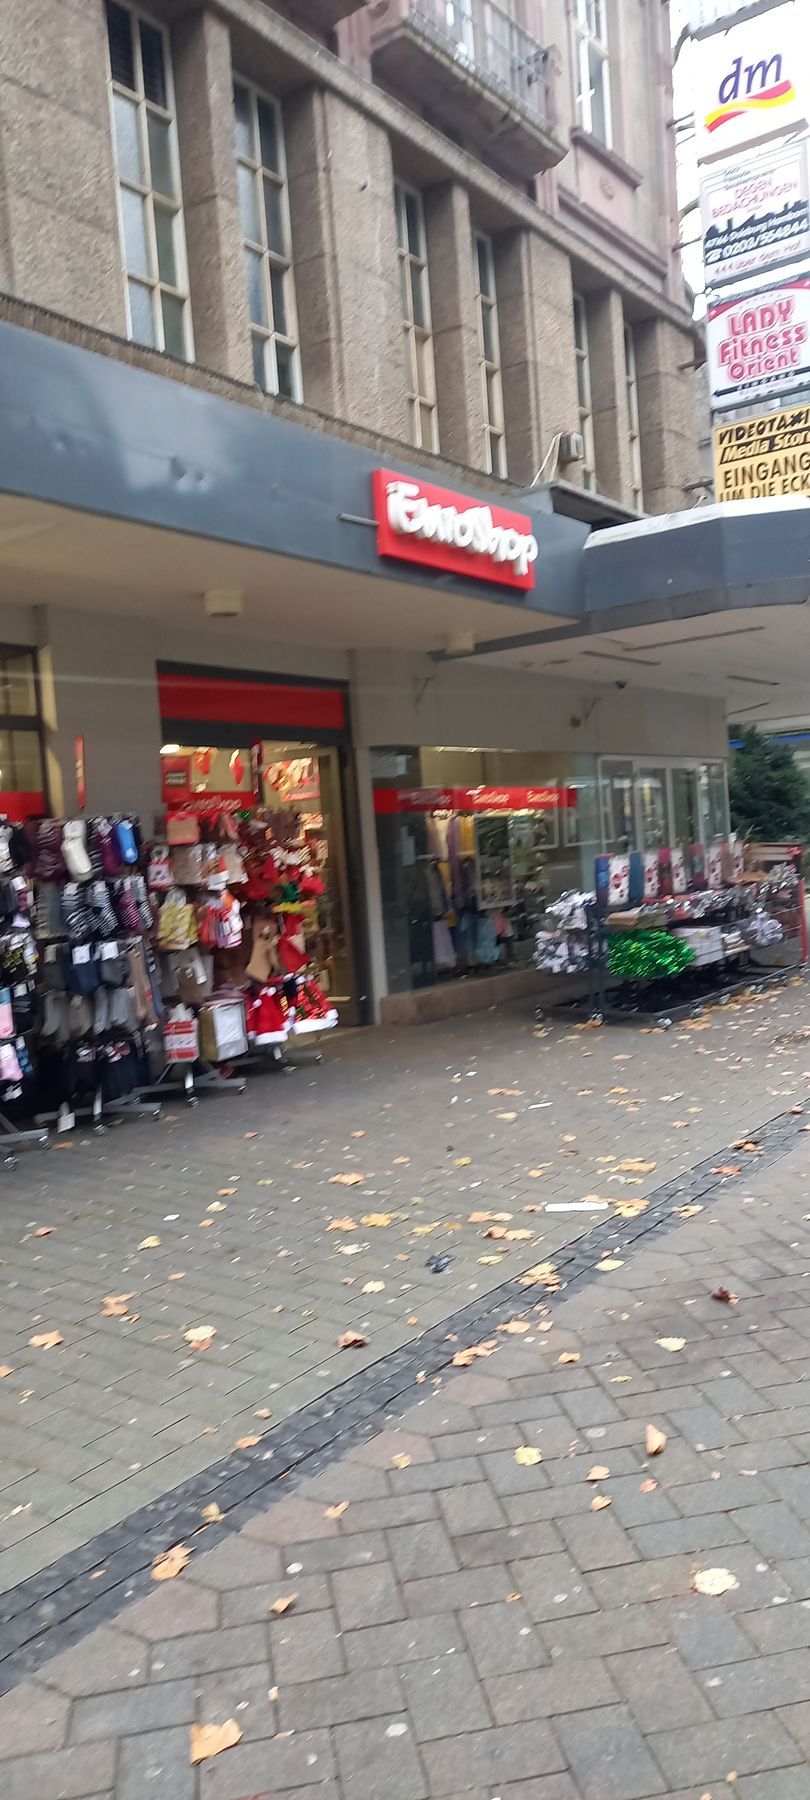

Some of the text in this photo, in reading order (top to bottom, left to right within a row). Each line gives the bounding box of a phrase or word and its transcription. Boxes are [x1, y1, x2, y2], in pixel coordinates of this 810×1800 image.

[719, 53, 783, 104] dm
[728, 295, 795, 337] LADY
[718, 322, 808, 366] Fitness
[728, 347, 800, 382] Orient
[721, 438, 771, 463] Media
[724, 451, 810, 489] EINGANG
[751, 481, 776, 499] DIE
[385, 480, 539, 576] EuroShop
